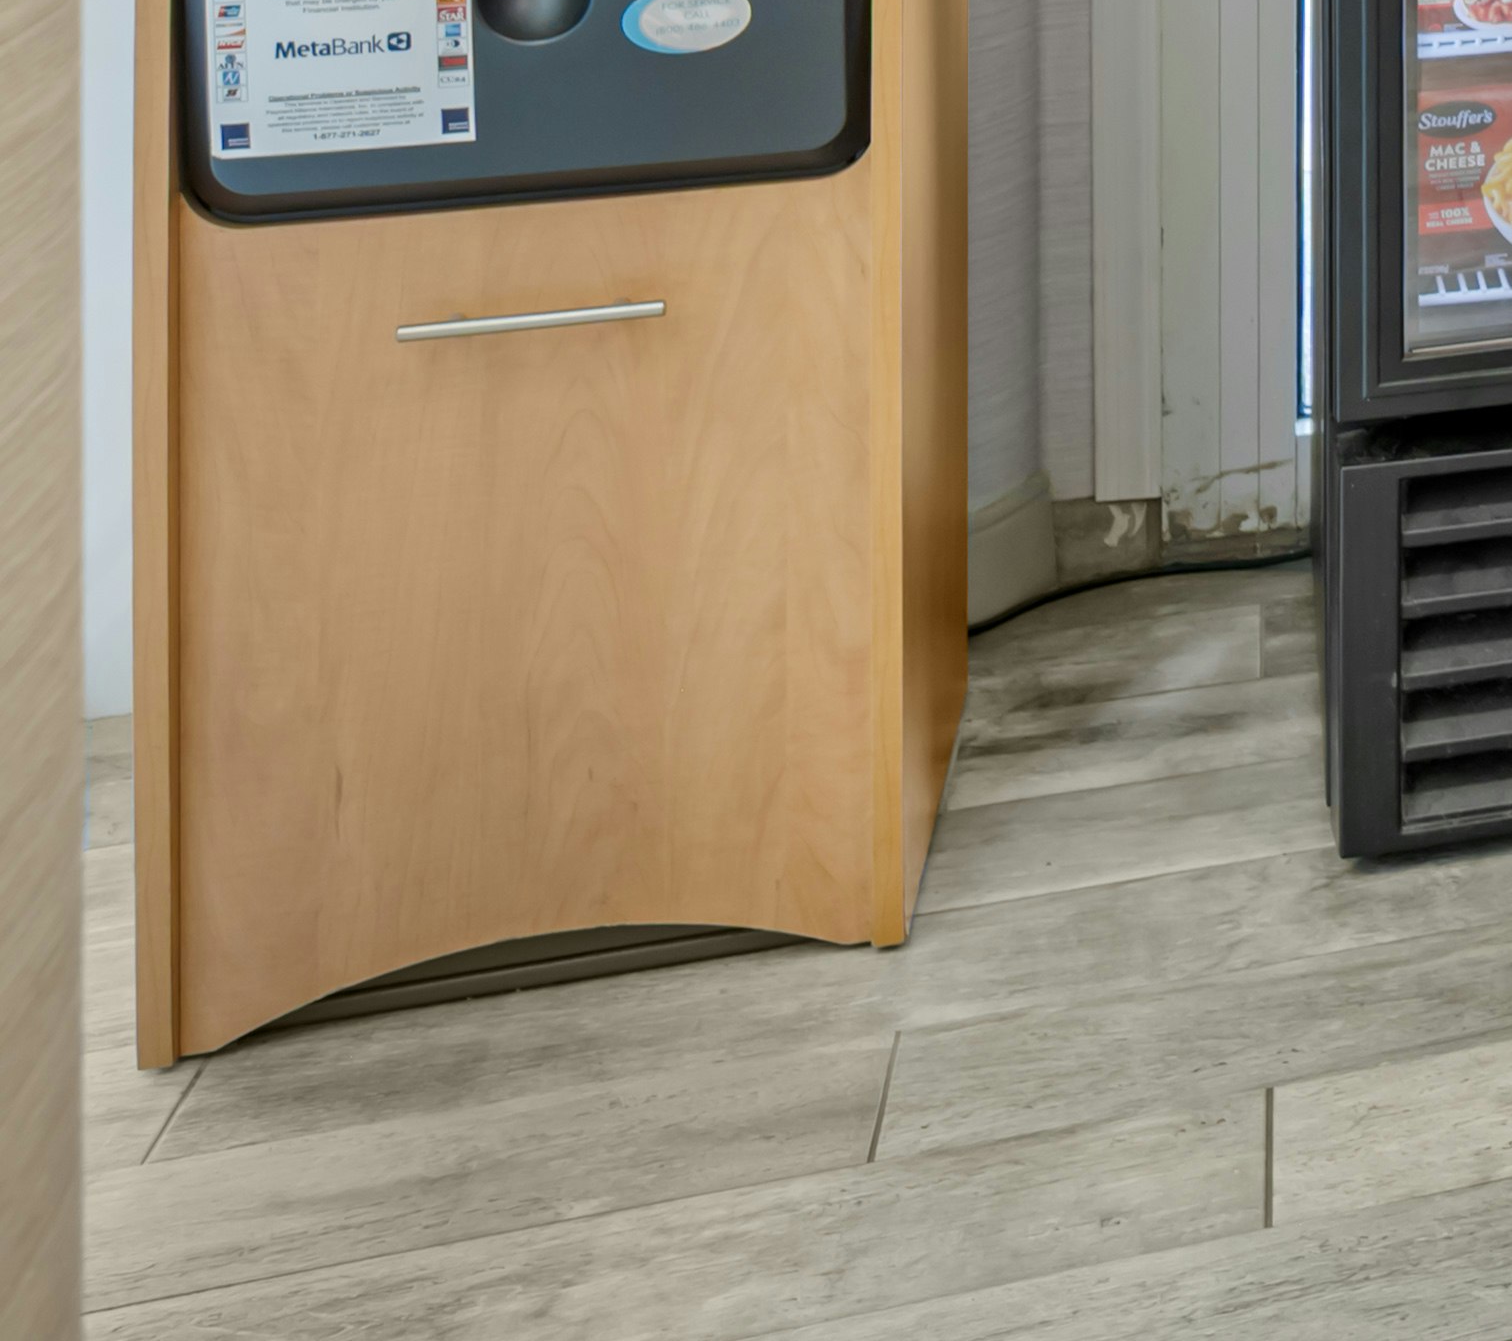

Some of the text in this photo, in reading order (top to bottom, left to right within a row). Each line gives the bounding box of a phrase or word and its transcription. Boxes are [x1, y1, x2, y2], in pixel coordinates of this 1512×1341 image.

[275, 34, 385, 59] MetaBank
[1418, 109, 1493, 130] Stouffer's
[1430, 141, 1481, 157] MAC &
[1425, 154, 1485, 170] CHEESE
